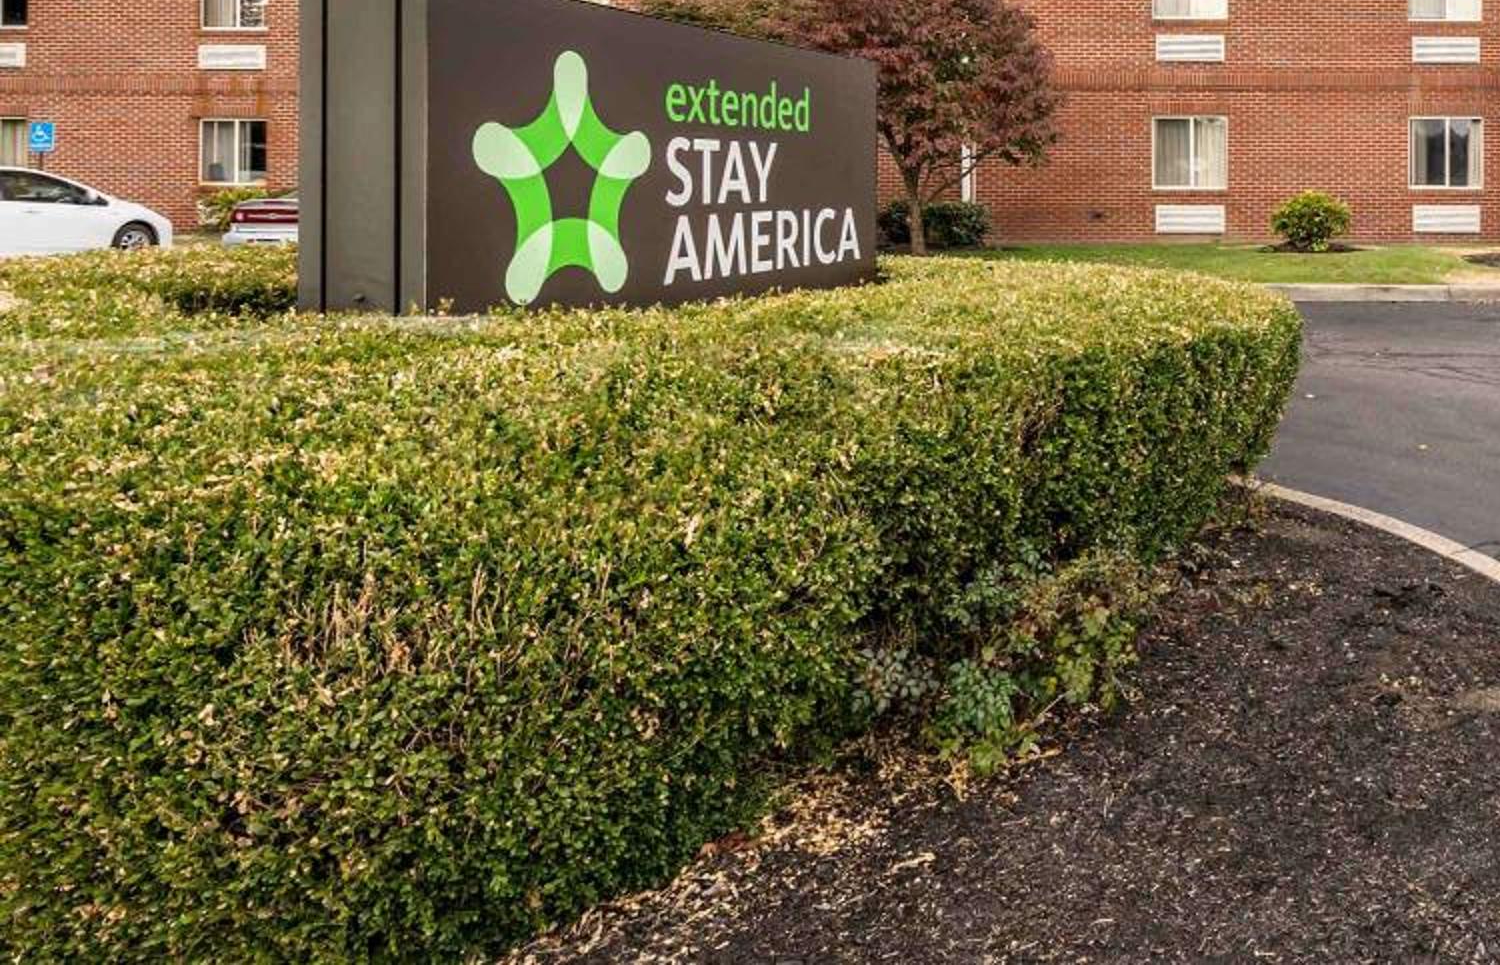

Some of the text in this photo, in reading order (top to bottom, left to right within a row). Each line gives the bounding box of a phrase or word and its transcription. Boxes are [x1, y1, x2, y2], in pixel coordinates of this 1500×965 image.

[665, 79, 810, 132] extended
[665, 136, 778, 207] STAY
[663, 207, 861, 286] AMERICA
